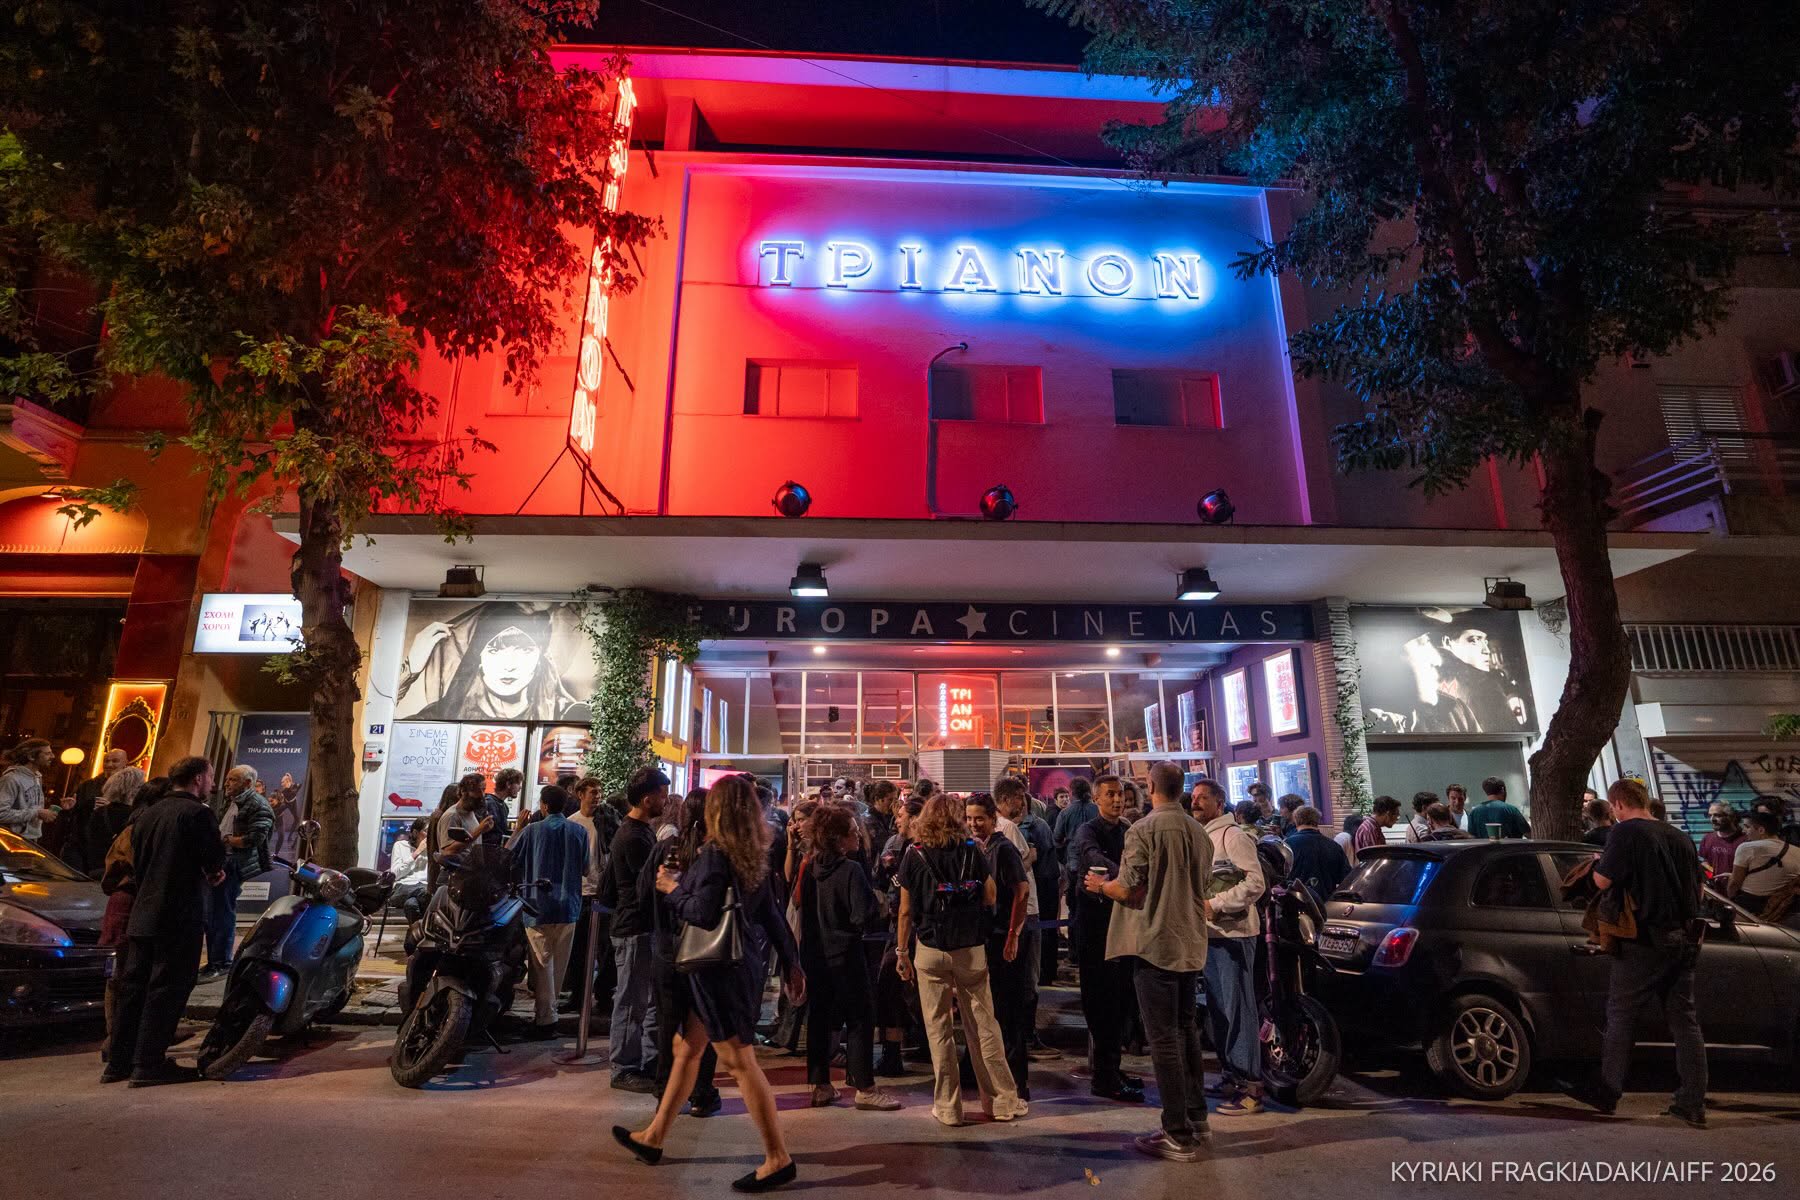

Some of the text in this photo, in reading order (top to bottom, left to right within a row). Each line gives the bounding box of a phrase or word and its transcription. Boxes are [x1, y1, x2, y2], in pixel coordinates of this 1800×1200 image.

[759, 240, 1202, 300] ΤΡΙΑΝΟΝ
[1008, 609, 1279, 637] CINEMAS
[372, 725, 382, 734] 21
[408, 728, 449, 738] ΣΙΝΕΜΑ
[432, 738, 448, 747] ΜΕ
[425, 747, 447, 756] ΤΟΝ
[402, 755, 446, 766] ΦΡΟΥΝΤ
